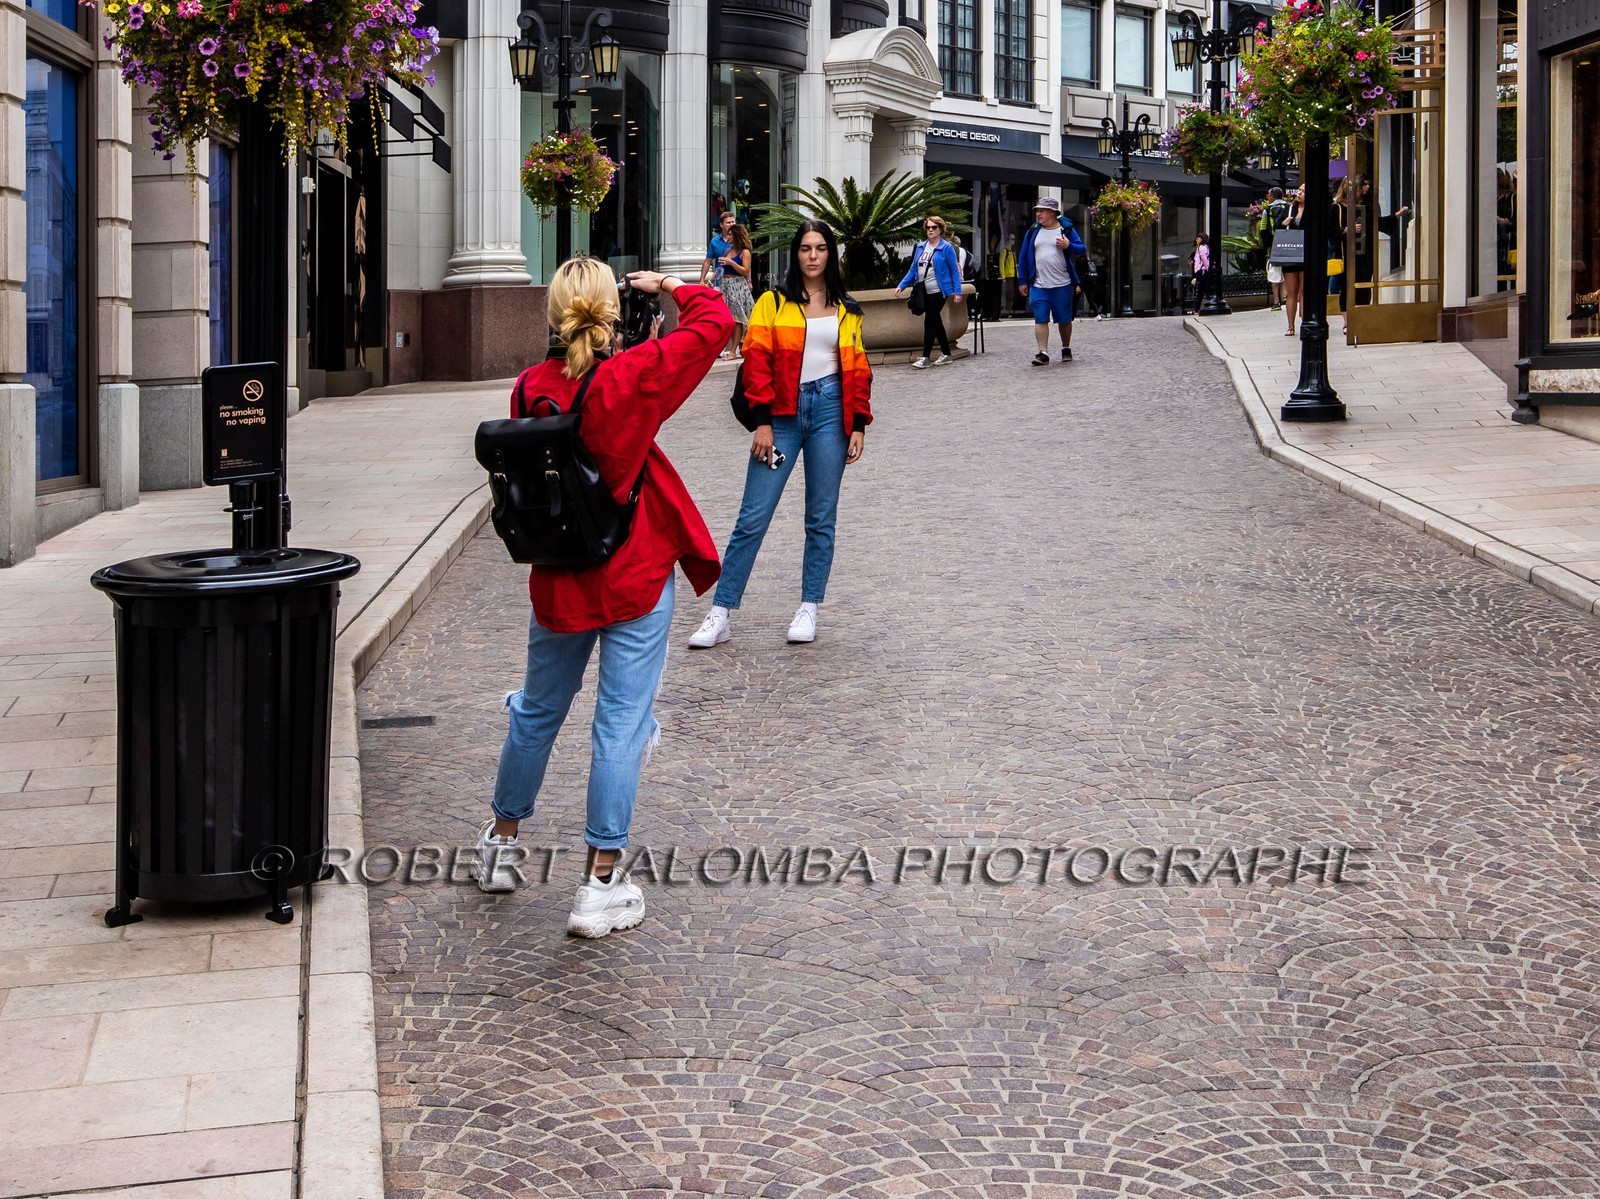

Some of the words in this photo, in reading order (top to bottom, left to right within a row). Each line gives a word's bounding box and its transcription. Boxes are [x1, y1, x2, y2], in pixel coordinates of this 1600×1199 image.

[926, 127, 968, 140] PORSCHE
[969, 132, 1000, 143] DESIGN
[232, 407, 264, 417] smoking
[239, 415, 266, 425] vaping
